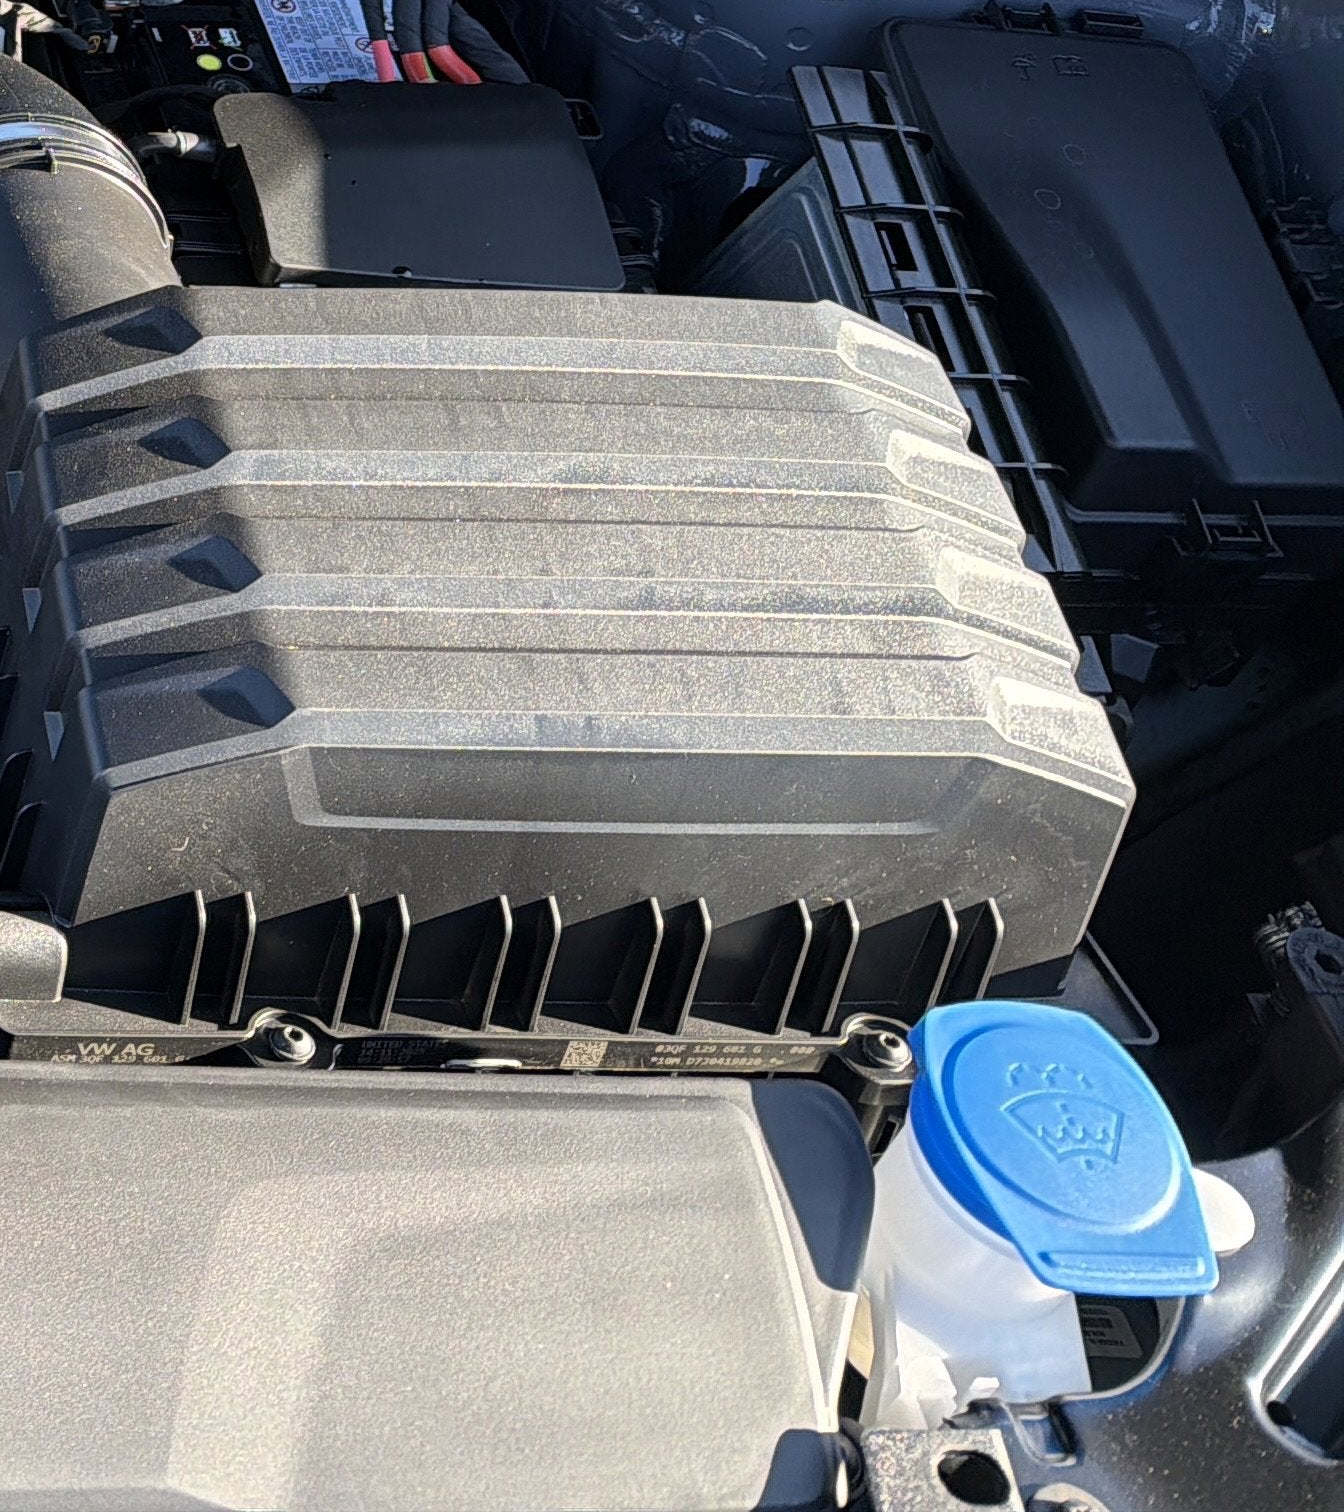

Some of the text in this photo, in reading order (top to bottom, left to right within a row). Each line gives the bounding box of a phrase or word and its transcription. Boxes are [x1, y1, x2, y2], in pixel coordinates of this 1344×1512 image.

[78, 1043, 155, 1056] VW AG
[693, 1045, 717, 1054] 129
[753, 1045, 763, 1054] G
[51, 1054, 77, 1063] ASM
[79, 1055, 105, 1065] 3QF
[112, 1055, 137, 1063] 129
